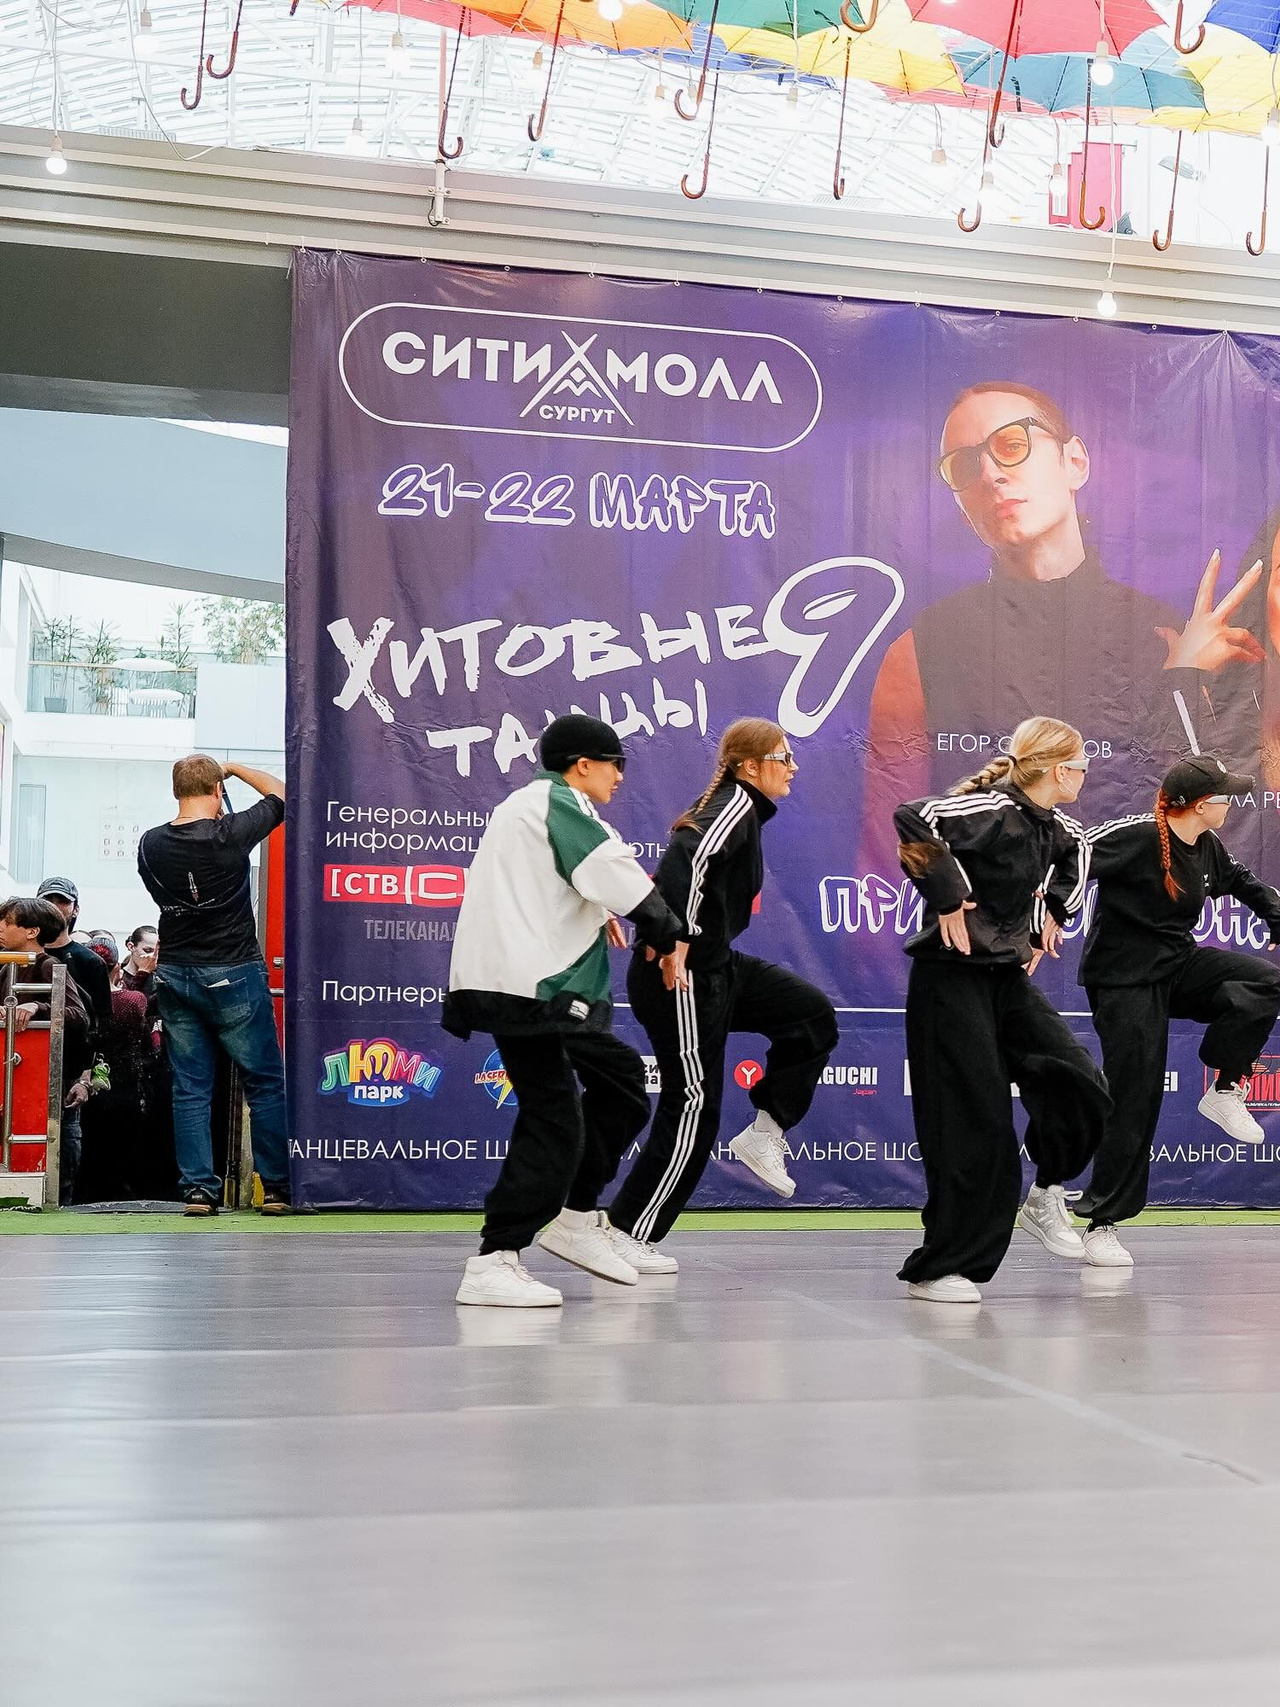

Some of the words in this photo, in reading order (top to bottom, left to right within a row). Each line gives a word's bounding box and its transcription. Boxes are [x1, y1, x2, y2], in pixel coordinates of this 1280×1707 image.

[382, 331, 553, 384] СИТИ
[607, 348, 784, 405] МОЛЛ
[539, 404, 616, 425] СУРГУТ
[377, 463, 576, 526] 21-22
[590, 472, 777, 540] МАРТА
[937, 733, 991, 753] ЕГОР
[320, 1041, 443, 1093] ЛЮМИ
[353, 1084, 404, 1103] парк
